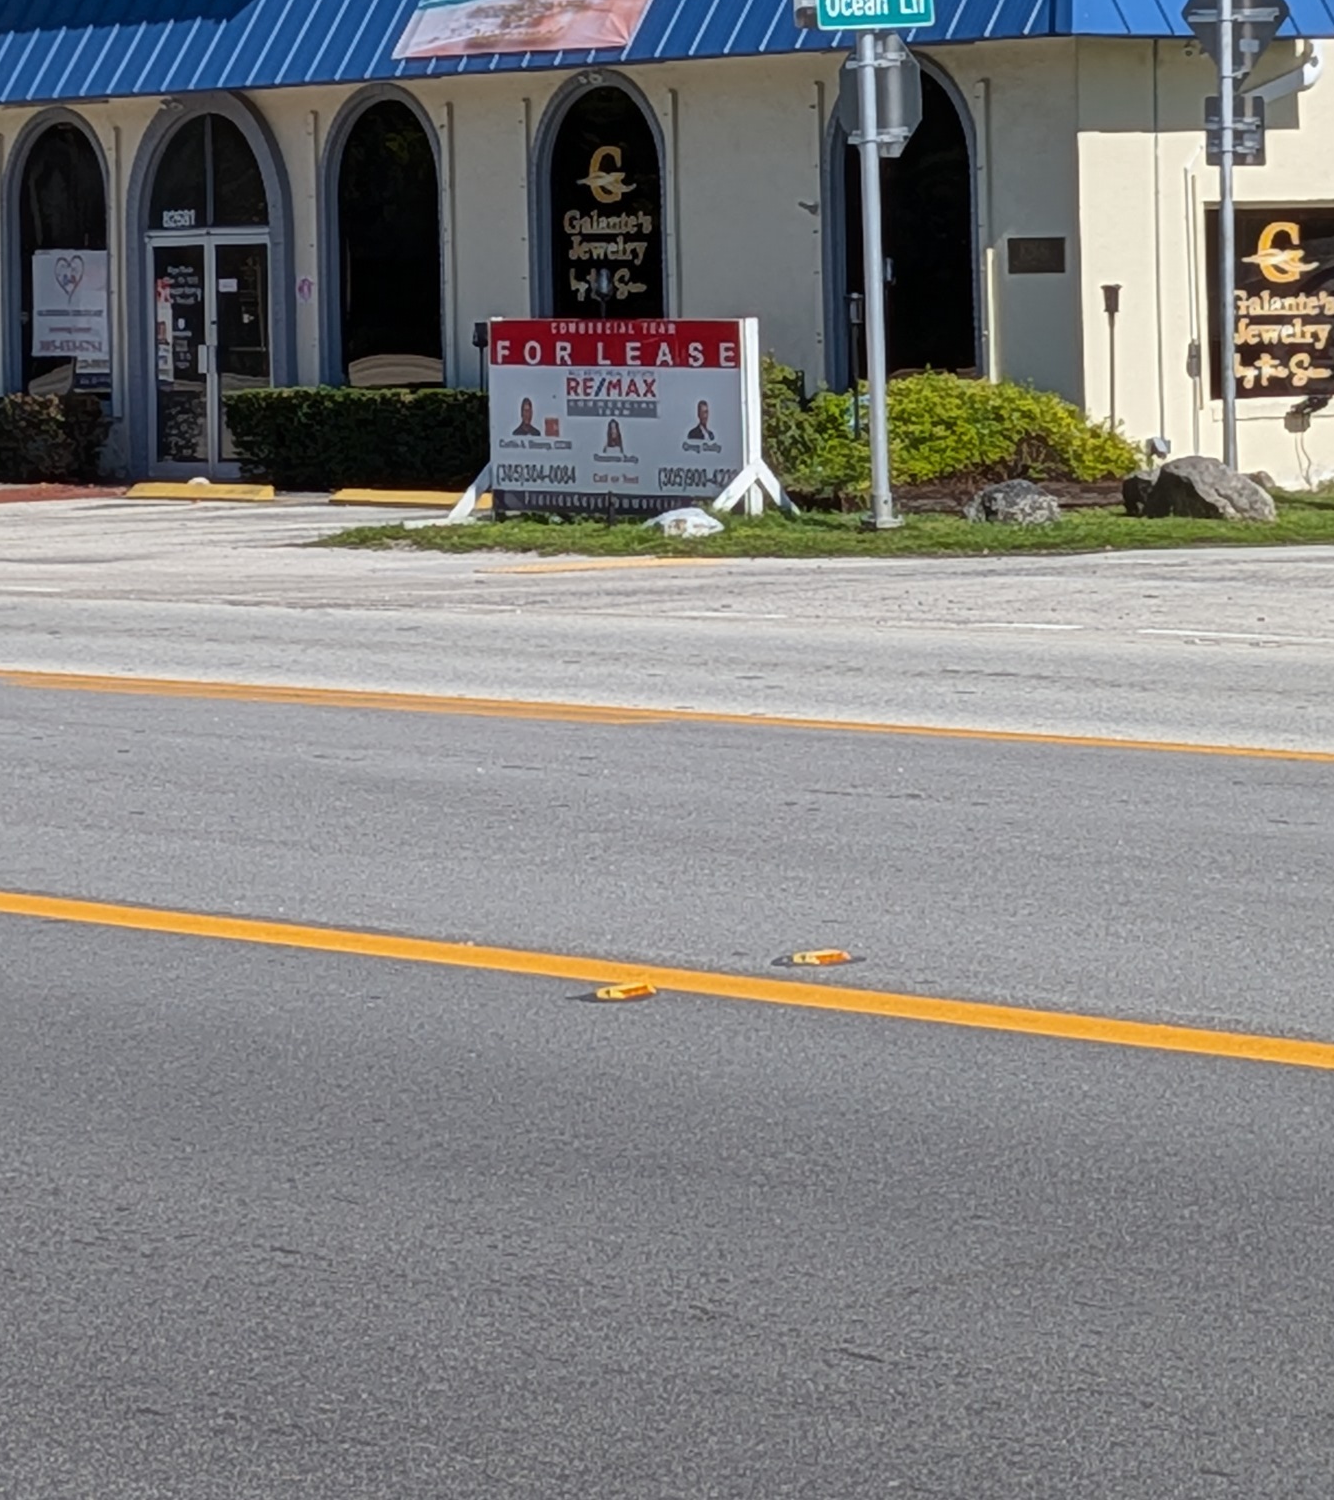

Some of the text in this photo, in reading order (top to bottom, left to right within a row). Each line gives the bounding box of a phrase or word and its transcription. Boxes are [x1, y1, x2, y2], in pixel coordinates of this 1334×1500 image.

[563, 209, 653, 234] Galante's
[569, 236, 648, 266] Jewelry
[551, 322, 677, 335] COMMERCIAL TEAM
[1234, 318, 1332, 349] Jewelry
[496, 340, 736, 368] FOR LEASE
[566, 377, 656, 398] RE/MAX
